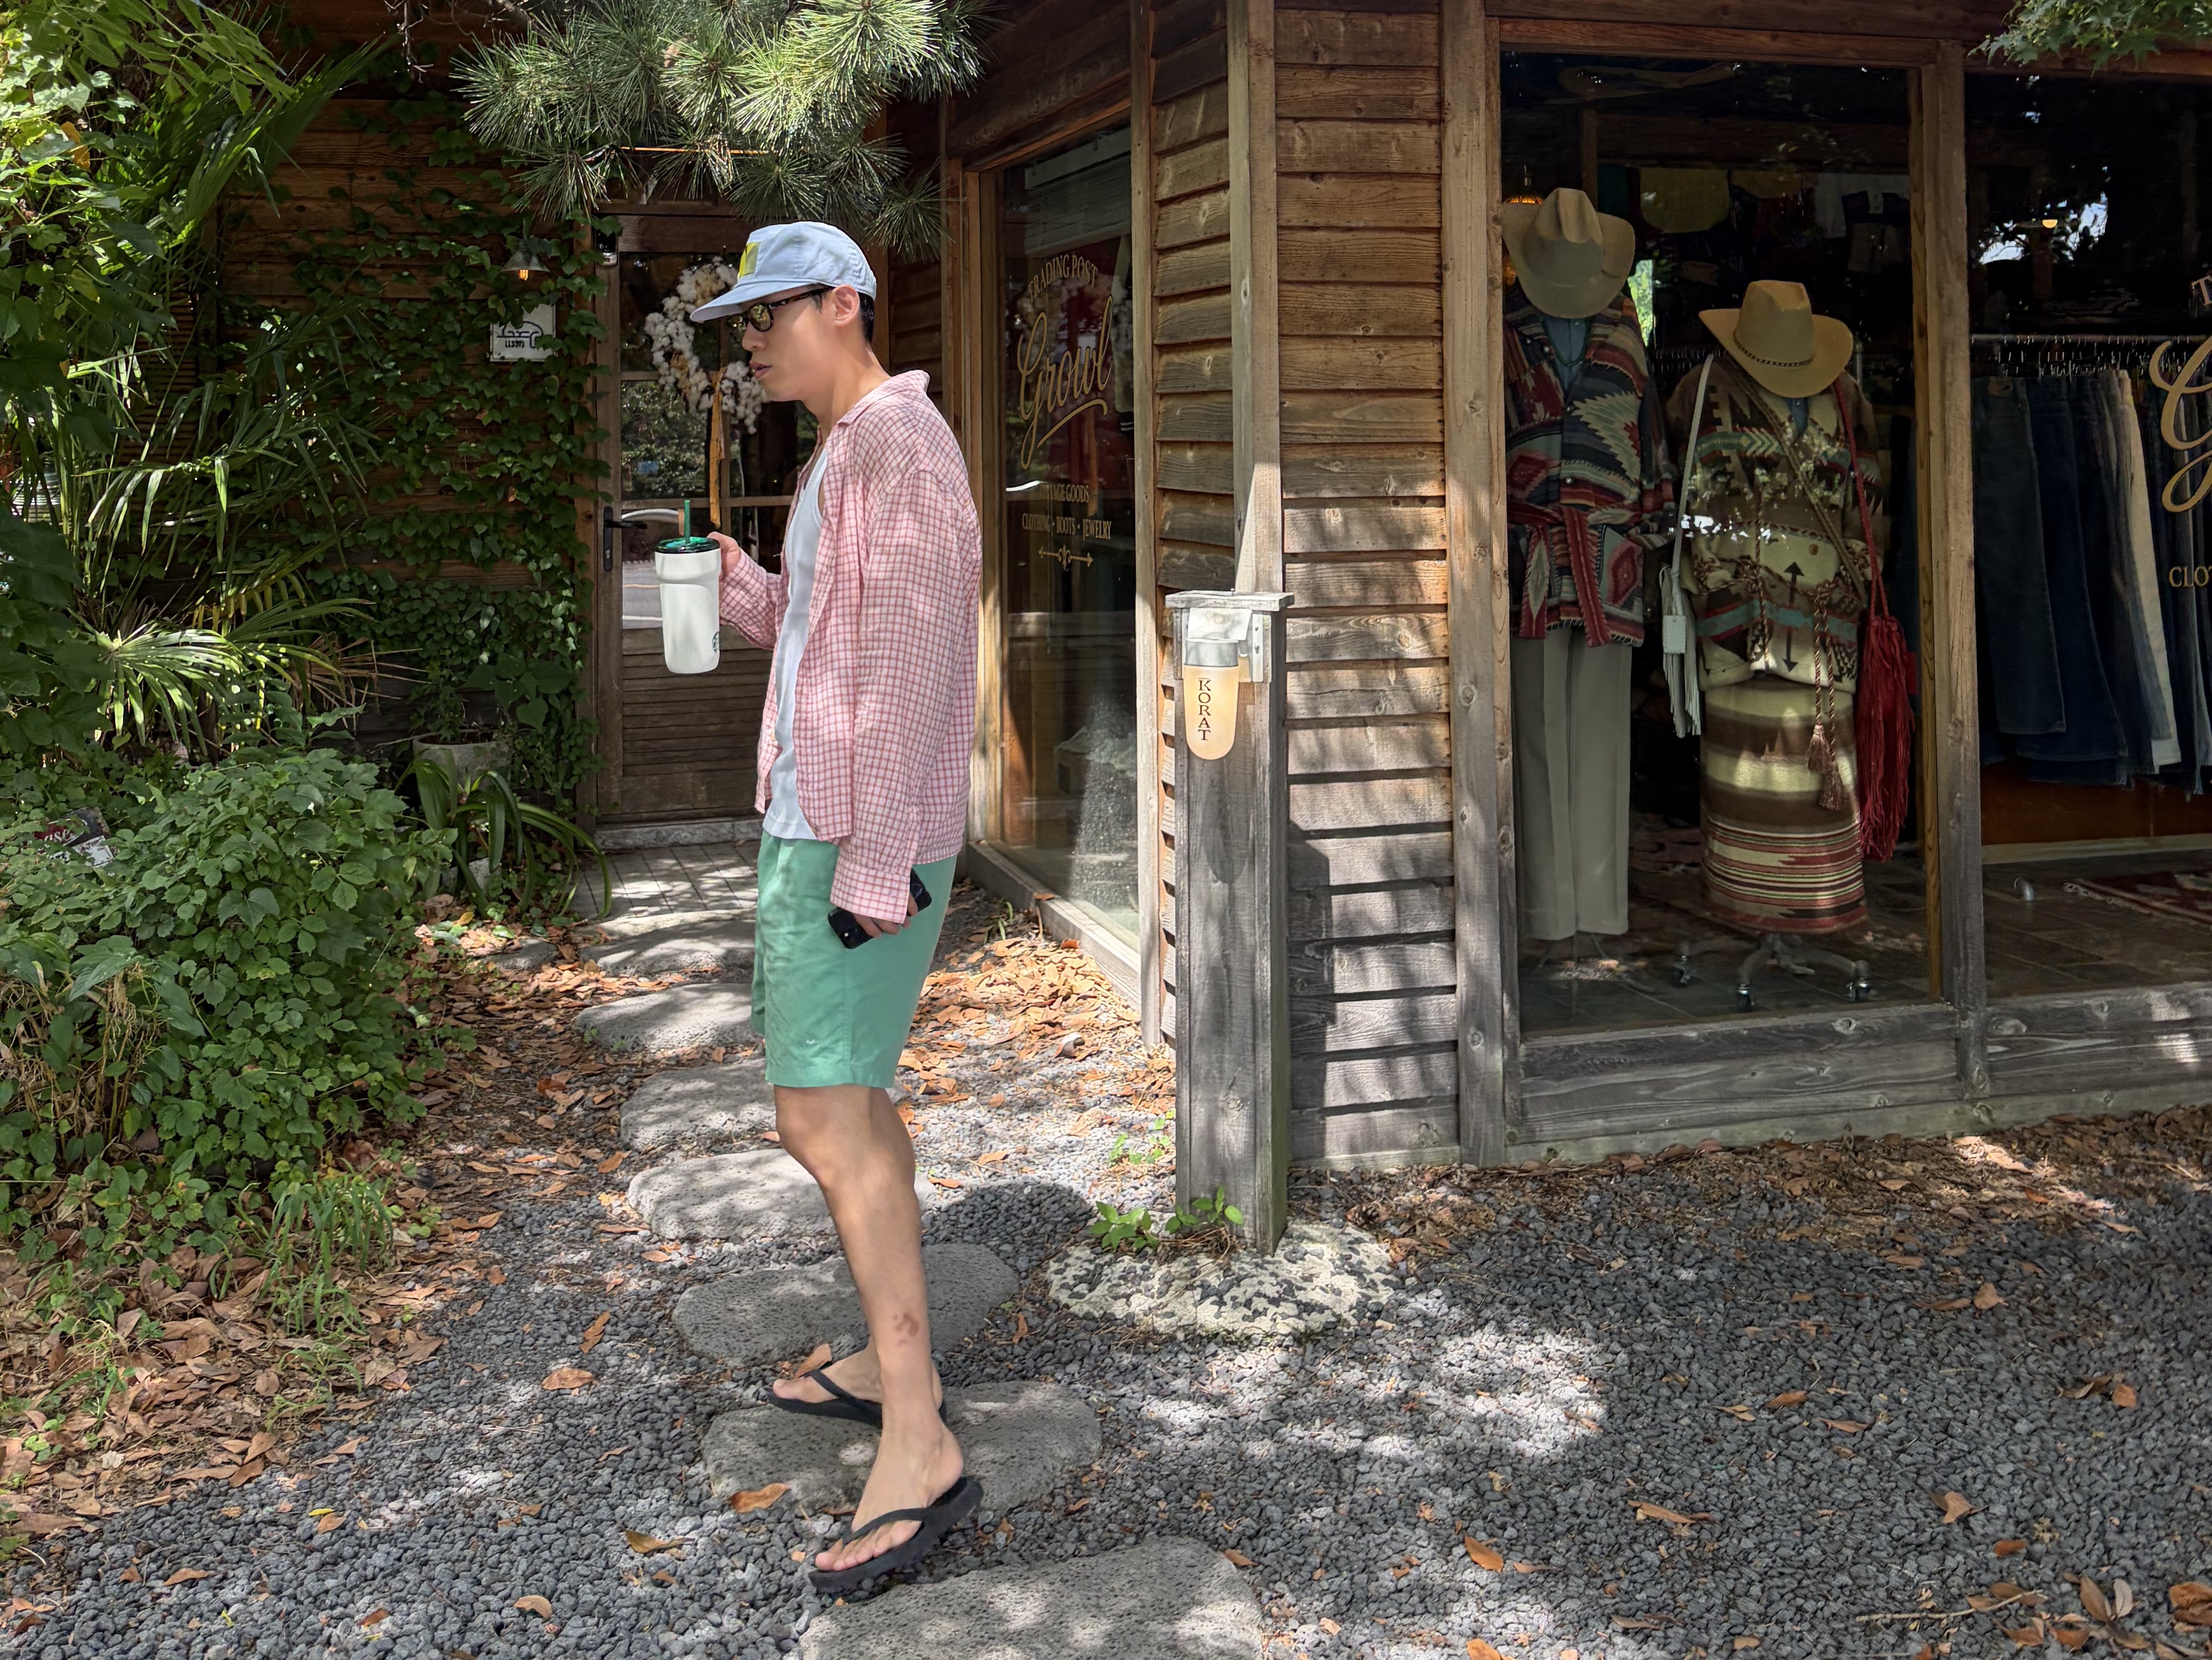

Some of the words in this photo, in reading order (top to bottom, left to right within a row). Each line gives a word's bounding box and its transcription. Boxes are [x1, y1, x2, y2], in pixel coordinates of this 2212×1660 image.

[1027, 254, 1070, 303] TRADING
[1071, 254, 1098, 288] POST
[1017, 295, 1113, 469] Growl
[1039, 483, 1066, 501] NTAGE
[1066, 484, 1089, 503] GOODS
[1022, 512, 1051, 533] CLOTHING
[1056, 516, 1076, 536] BOOTS
[1082, 518, 1112, 541] JEWELRY
[2169, 565, 2212, 587] CLO
[1198, 678, 1211, 741] KORAT
